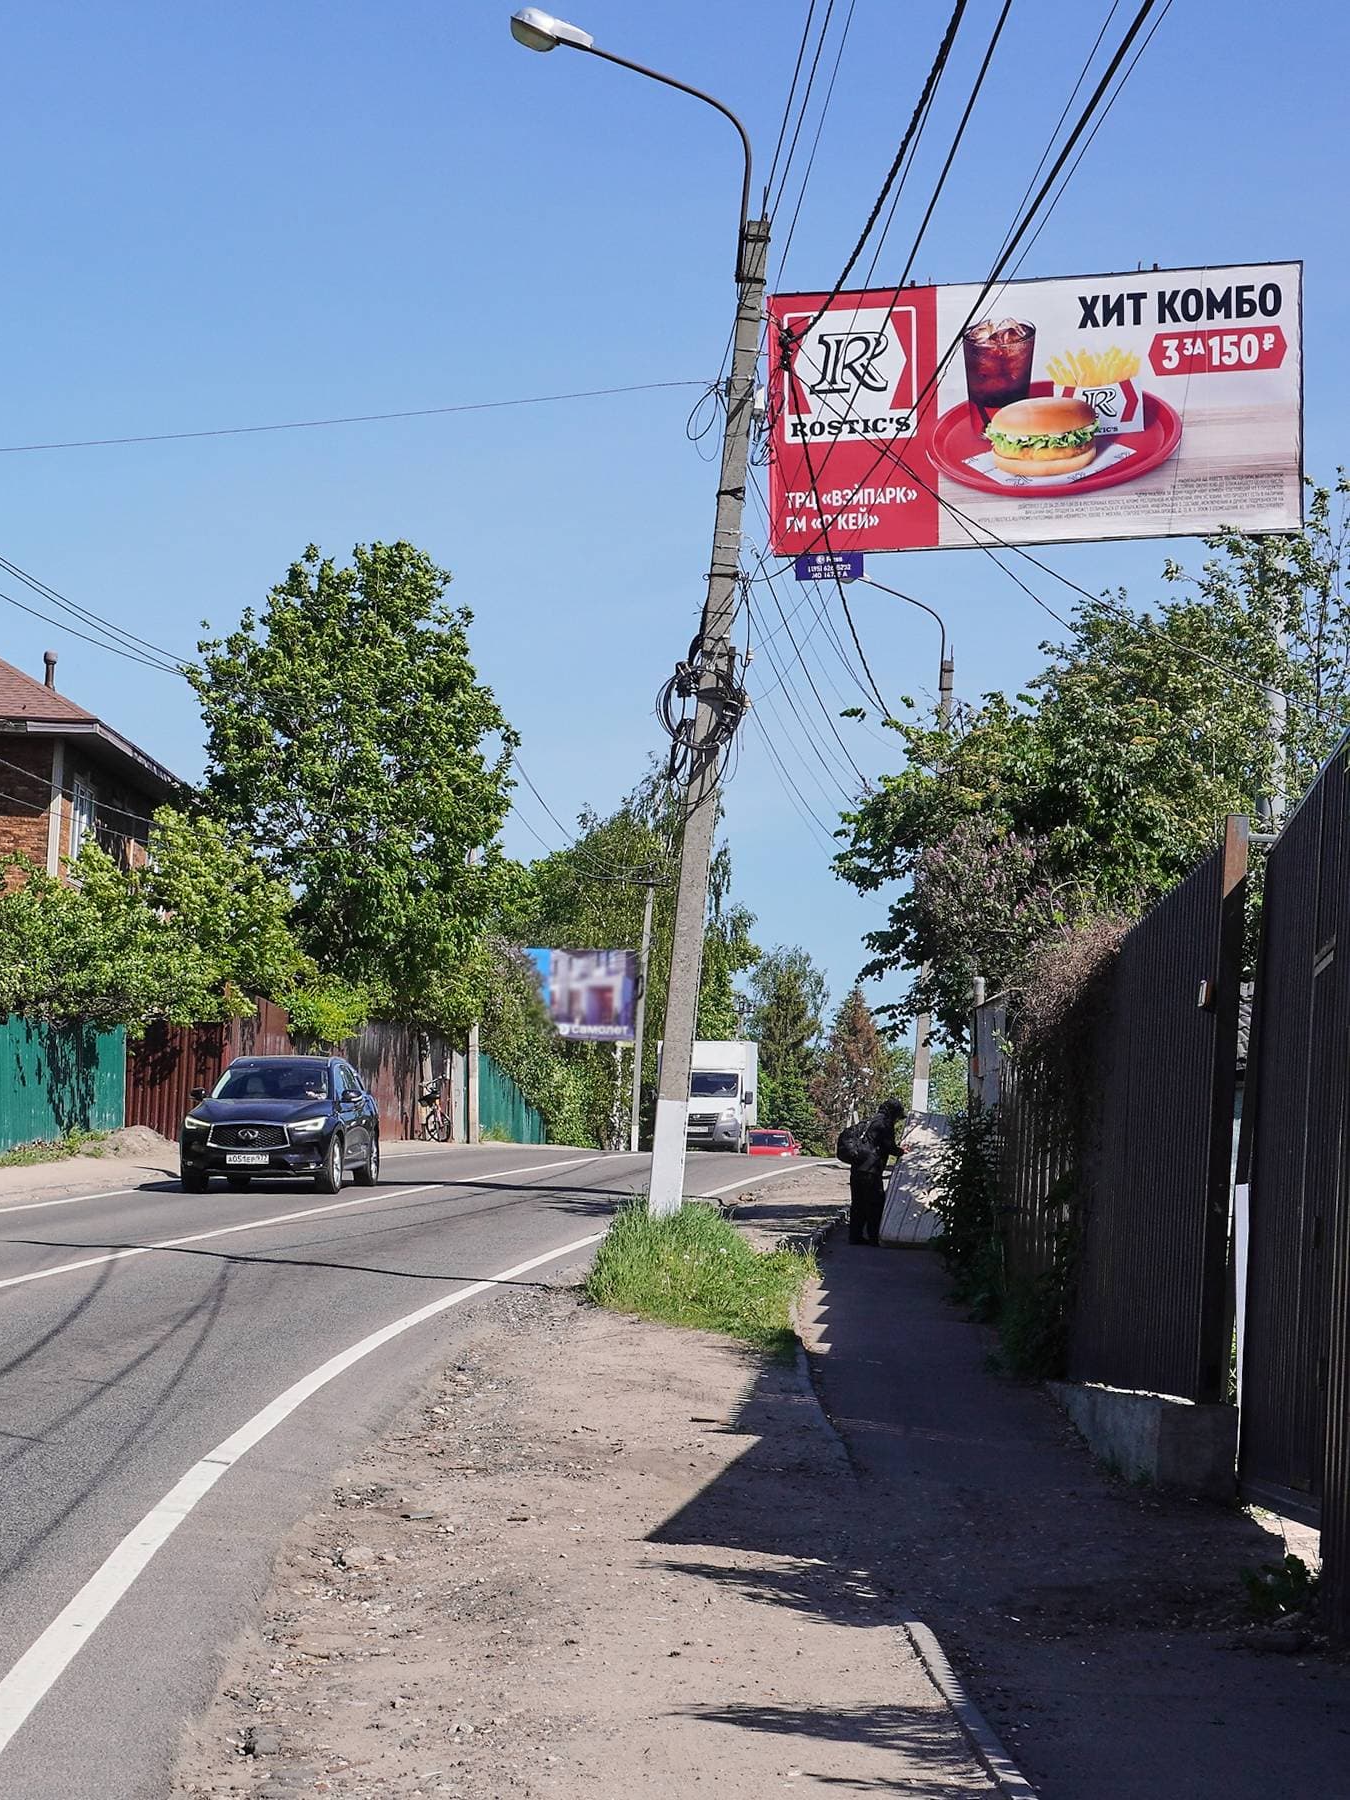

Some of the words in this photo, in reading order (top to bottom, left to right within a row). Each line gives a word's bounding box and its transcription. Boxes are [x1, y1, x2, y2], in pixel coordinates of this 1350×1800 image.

[1078, 292, 1147, 329] ХИТ
[1157, 282, 1282, 324] КОМБО
[1161, 338, 1180, 370] 3
[790, 416, 911, 438] ROSTIC'S
[785, 490, 818, 511] ТРЦ
[785, 516, 807, 533] ГМ
